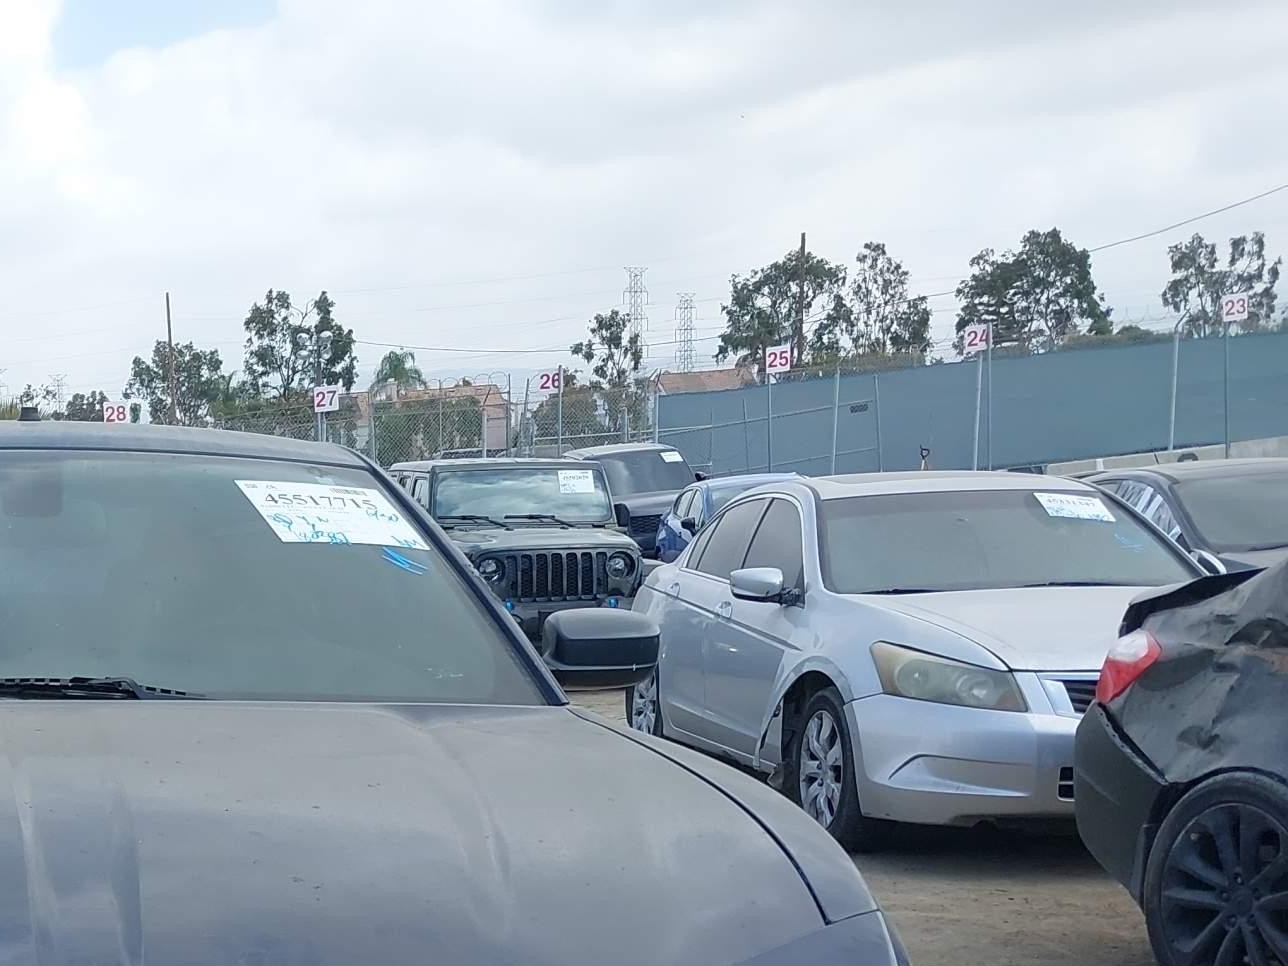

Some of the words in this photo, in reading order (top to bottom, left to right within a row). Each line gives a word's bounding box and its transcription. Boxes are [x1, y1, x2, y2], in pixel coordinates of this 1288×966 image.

[1224, 299, 1246, 316] 23
[967, 330, 988, 347] 24
[767, 351, 789, 368] 25
[540, 373, 560, 390] 26
[315, 390, 337, 408] 27
[105, 405, 127, 423] 28
[265, 493, 378, 510] 45517715
